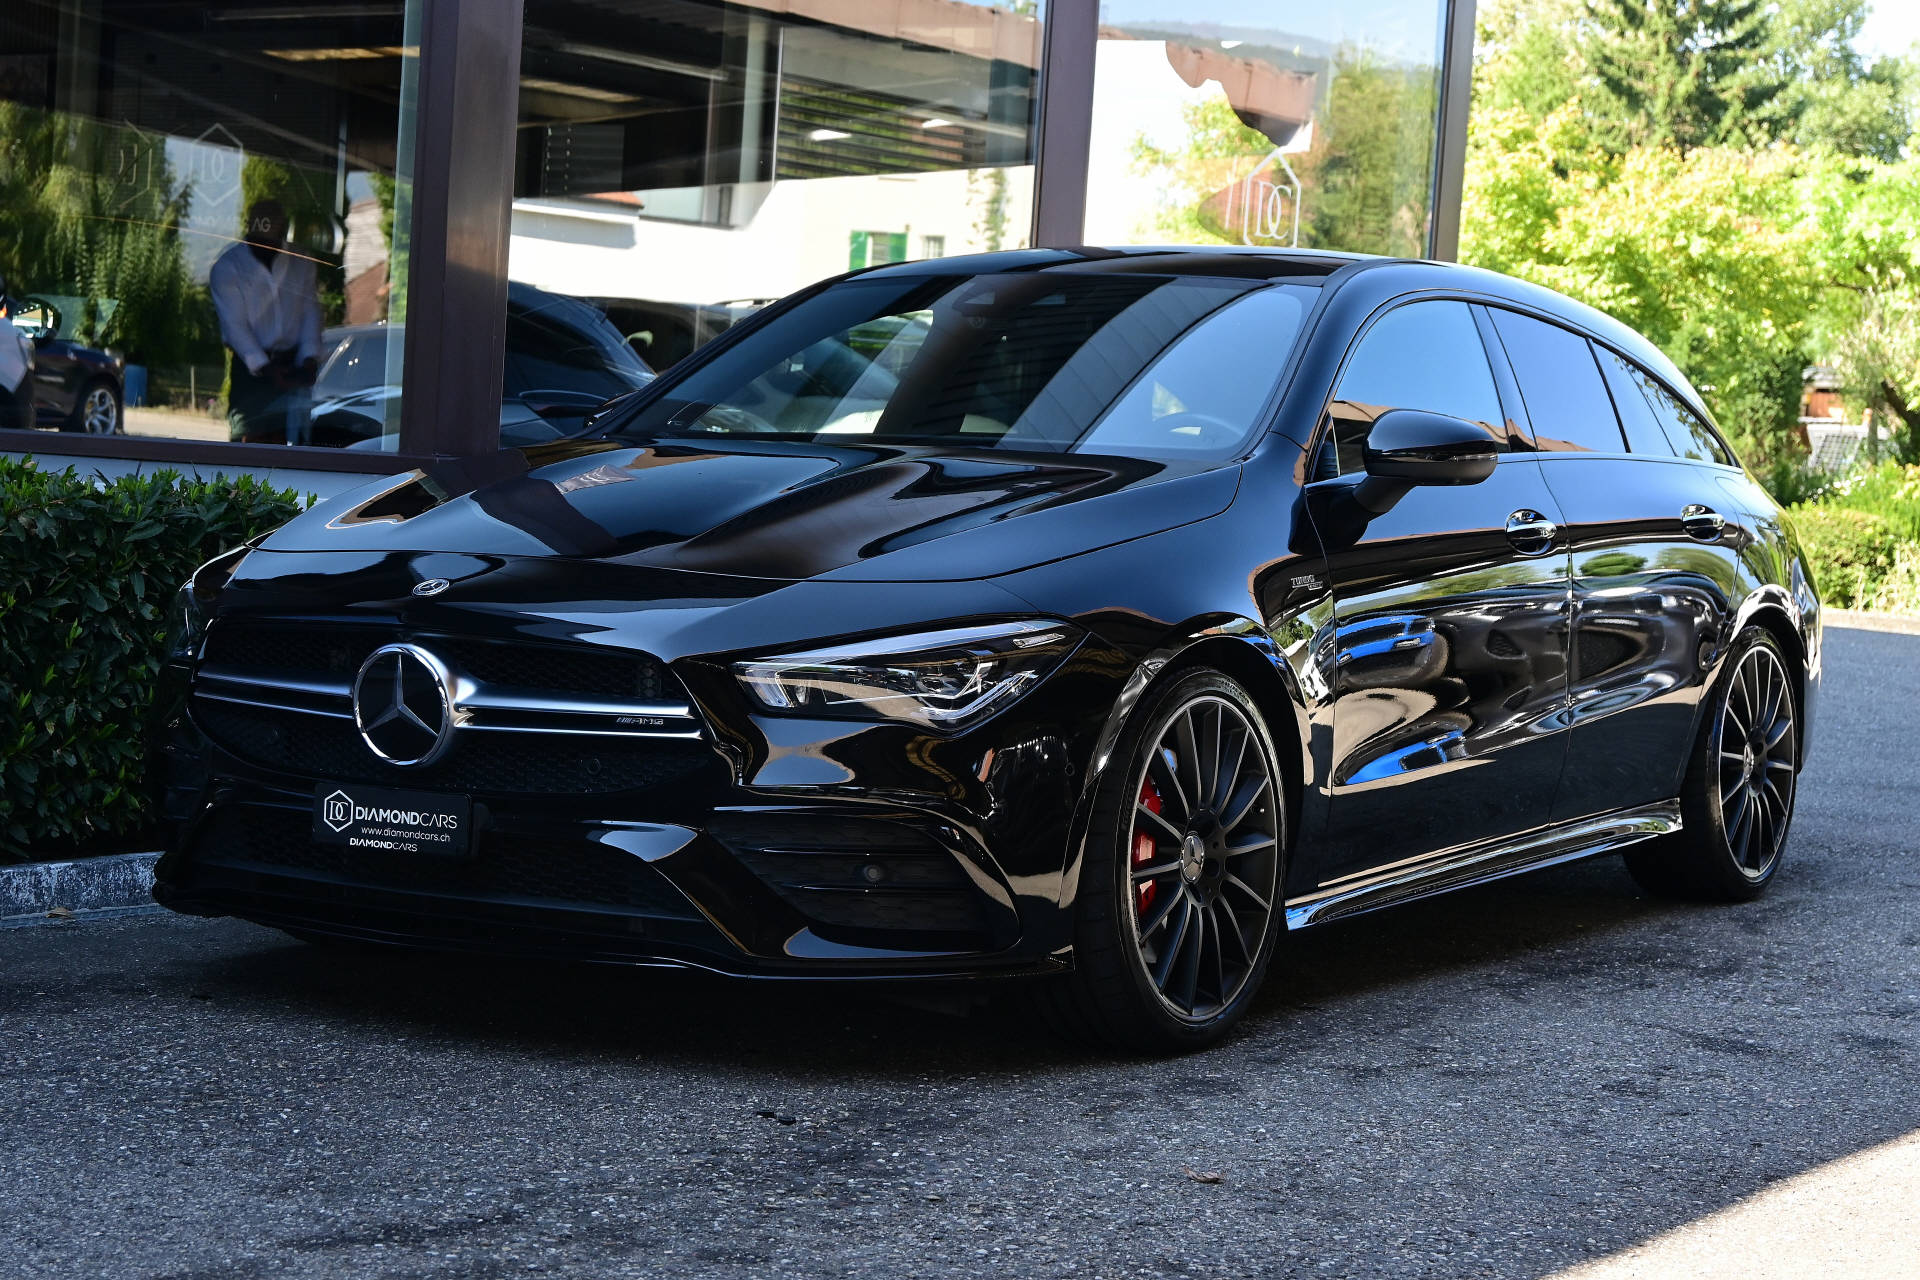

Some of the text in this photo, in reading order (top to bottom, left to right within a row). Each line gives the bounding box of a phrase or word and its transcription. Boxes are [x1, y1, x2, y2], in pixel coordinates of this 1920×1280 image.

[1255, 181, 1292, 240] DC
[251, 217, 272, 233] AG
[328, 800, 458, 829] DC DIAMONDCARS
[361, 826, 451, 842] www.diamondcars.ch
[350, 837, 418, 852] DIAMONDCARS
